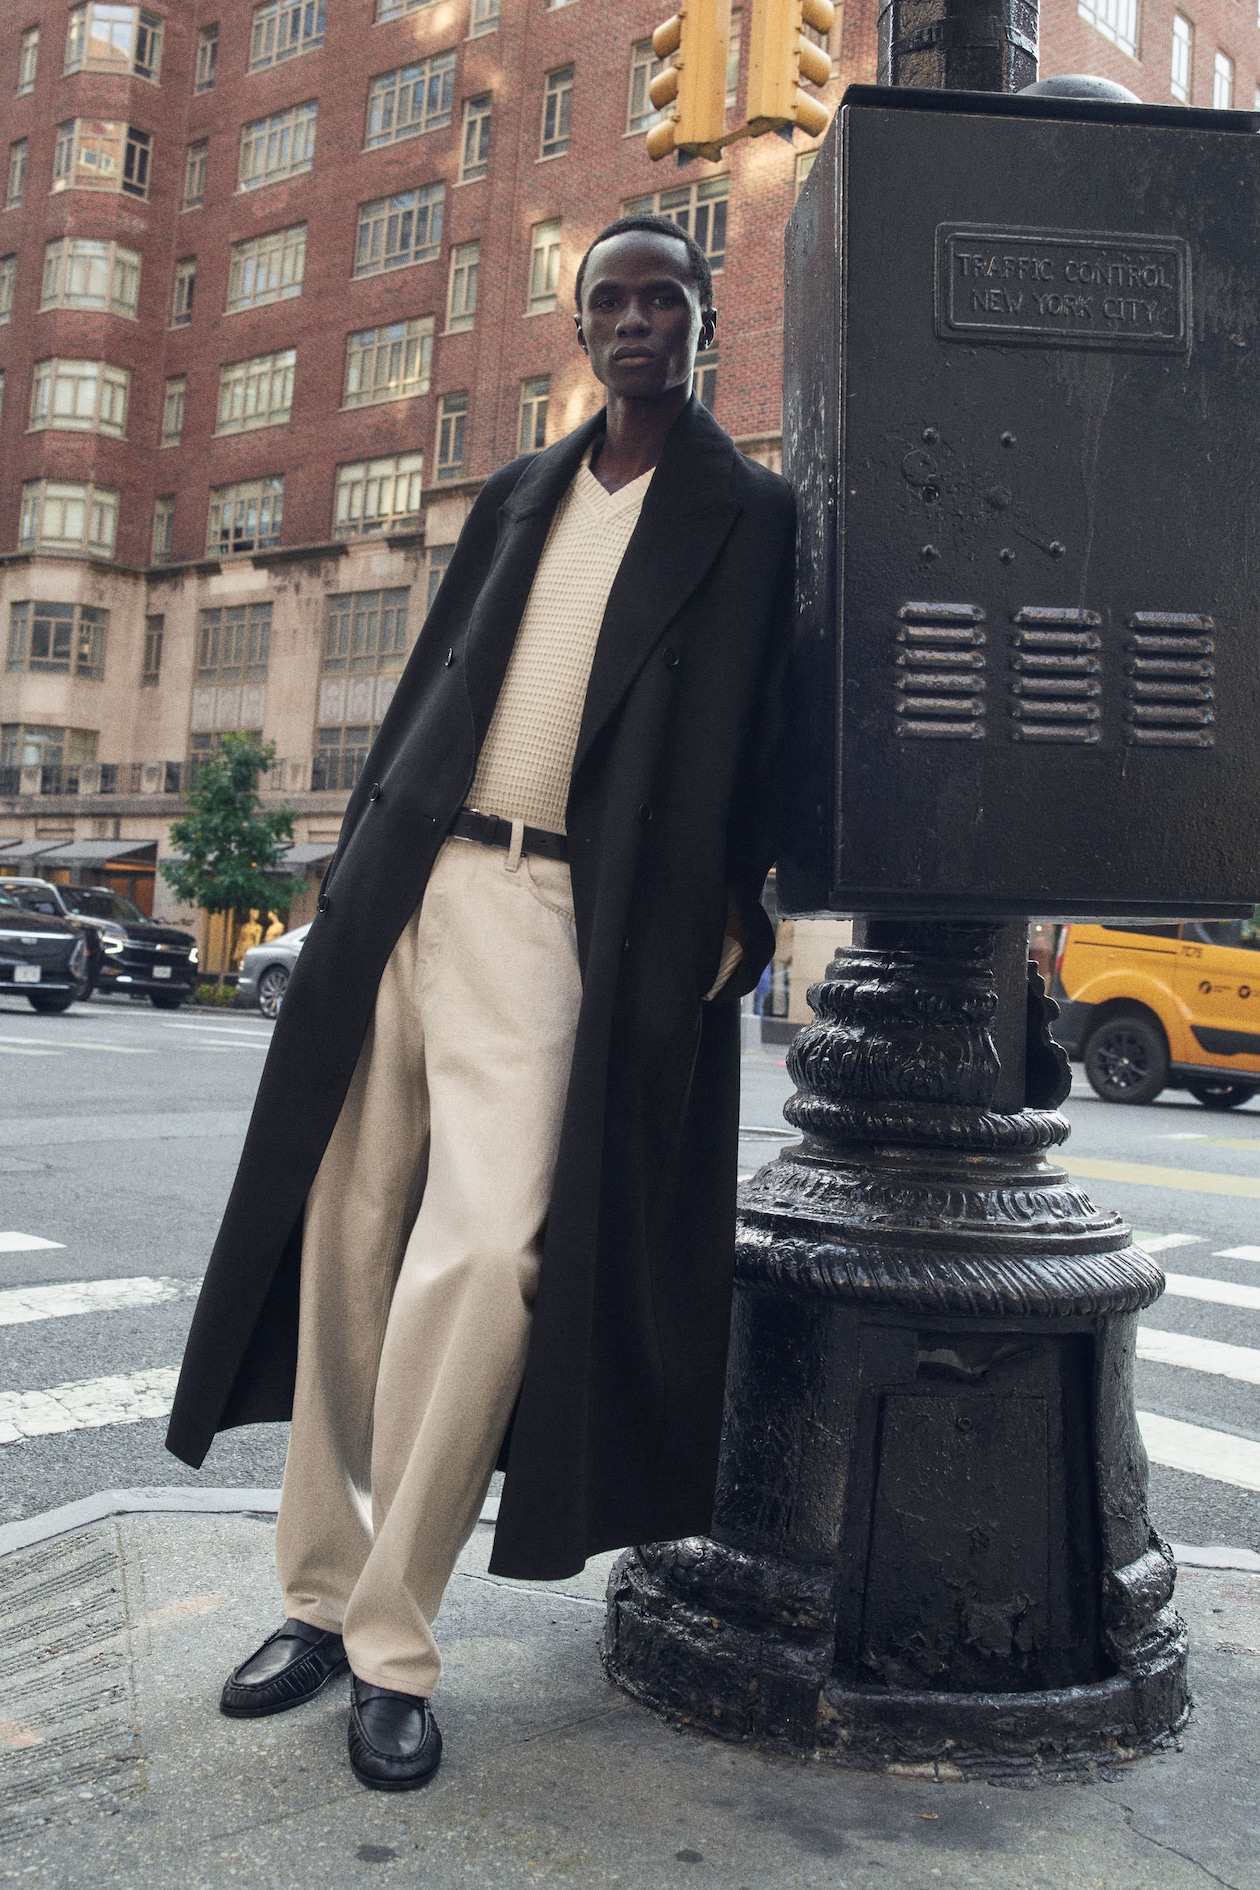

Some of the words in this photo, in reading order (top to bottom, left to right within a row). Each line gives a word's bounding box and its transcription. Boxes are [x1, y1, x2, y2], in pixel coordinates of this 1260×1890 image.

[957, 253, 1054, 281] TRAFFIC
[1064, 260, 1173, 290] CONTROL
[972, 288, 1024, 313] NEW
[1033, 293, 1094, 318] YORK
[1103, 297, 1158, 322] CITY
